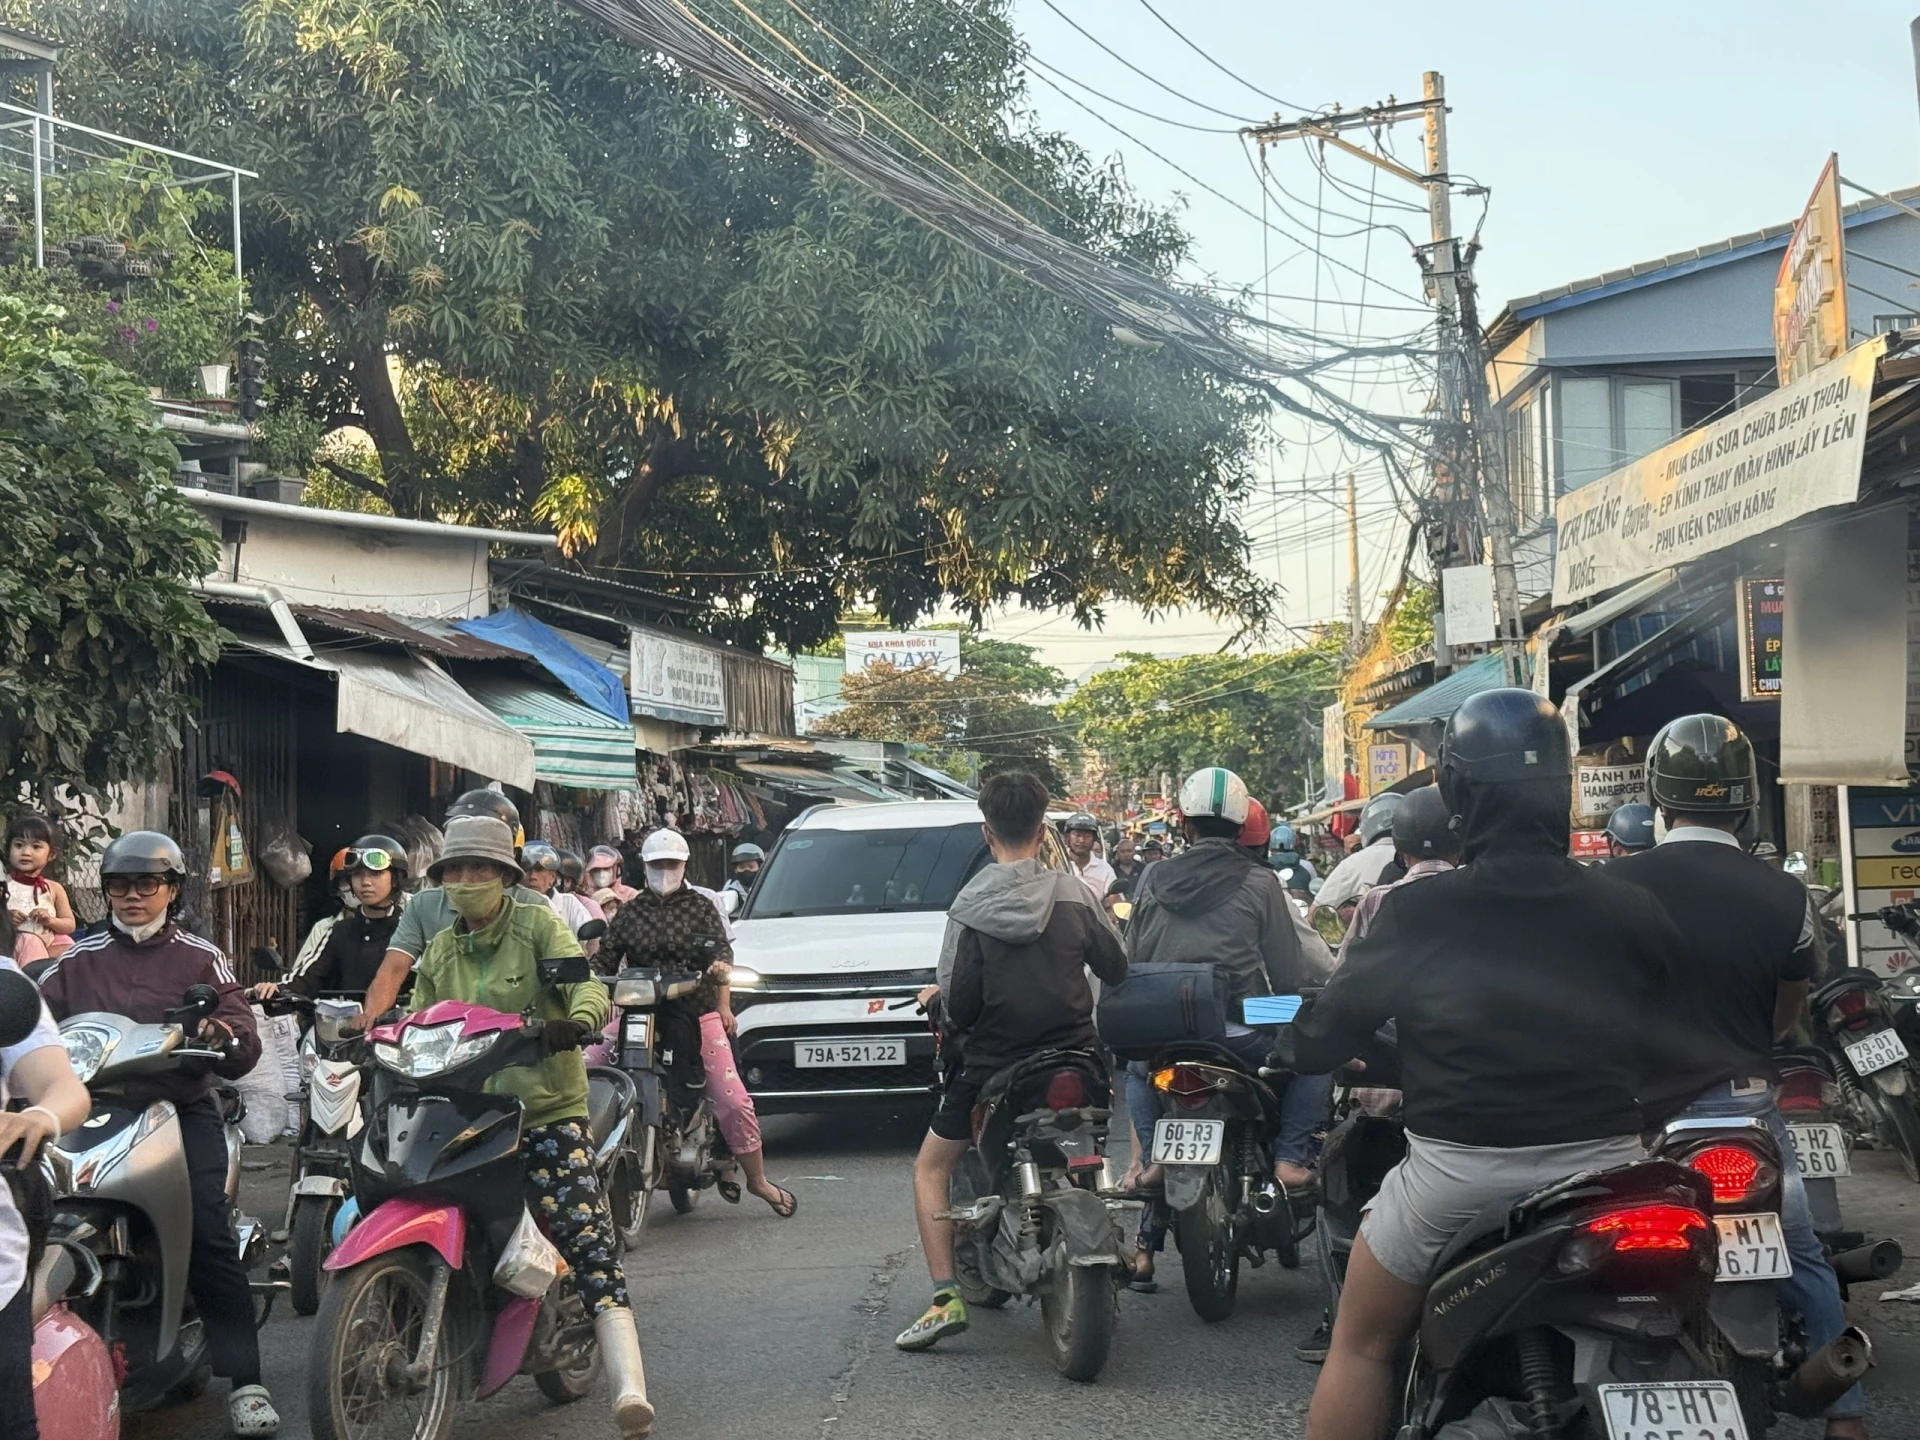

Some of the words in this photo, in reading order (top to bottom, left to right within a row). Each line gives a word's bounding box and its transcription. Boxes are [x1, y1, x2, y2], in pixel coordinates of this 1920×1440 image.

[1665, 453, 1689, 481] MUA
[1778, 395, 1809, 430] ĐIỆN
[1812, 375, 1851, 415] THOẠI
[1659, 492, 1673, 517] ÉP
[1674, 482, 1701, 511] KÍNH
[1703, 468, 1733, 499] THAY
[1733, 454, 1763, 487] MÀN
[1764, 440, 1796, 474] HÌNH
[1581, 485, 1621, 541] THẮNG
[1655, 526, 1675, 553] PHỤ
[1678, 514, 1703, 546] KIỆN
[1707, 500, 1741, 535] CHÍNH
[885, 640, 904, 648] KHOA
[907, 638, 926, 648] QUỐC
[1765, 638, 1780, 652] ÉP
[863, 650, 943, 668] GALAXY
[1581, 769, 1623, 783] BÁNH
[1583, 781, 1645, 797] HAMBERGER
[1593, 802, 1609, 811] 3K
[804, 1046, 897, 1063] 79A-521.22
[1165, 1122, 1213, 1141] 60-R3
[1162, 1142, 1211, 1161] 7637
[1617, 1295, 1659, 1303] HONDA
[1621, 1388, 1718, 1426] 78-H1
